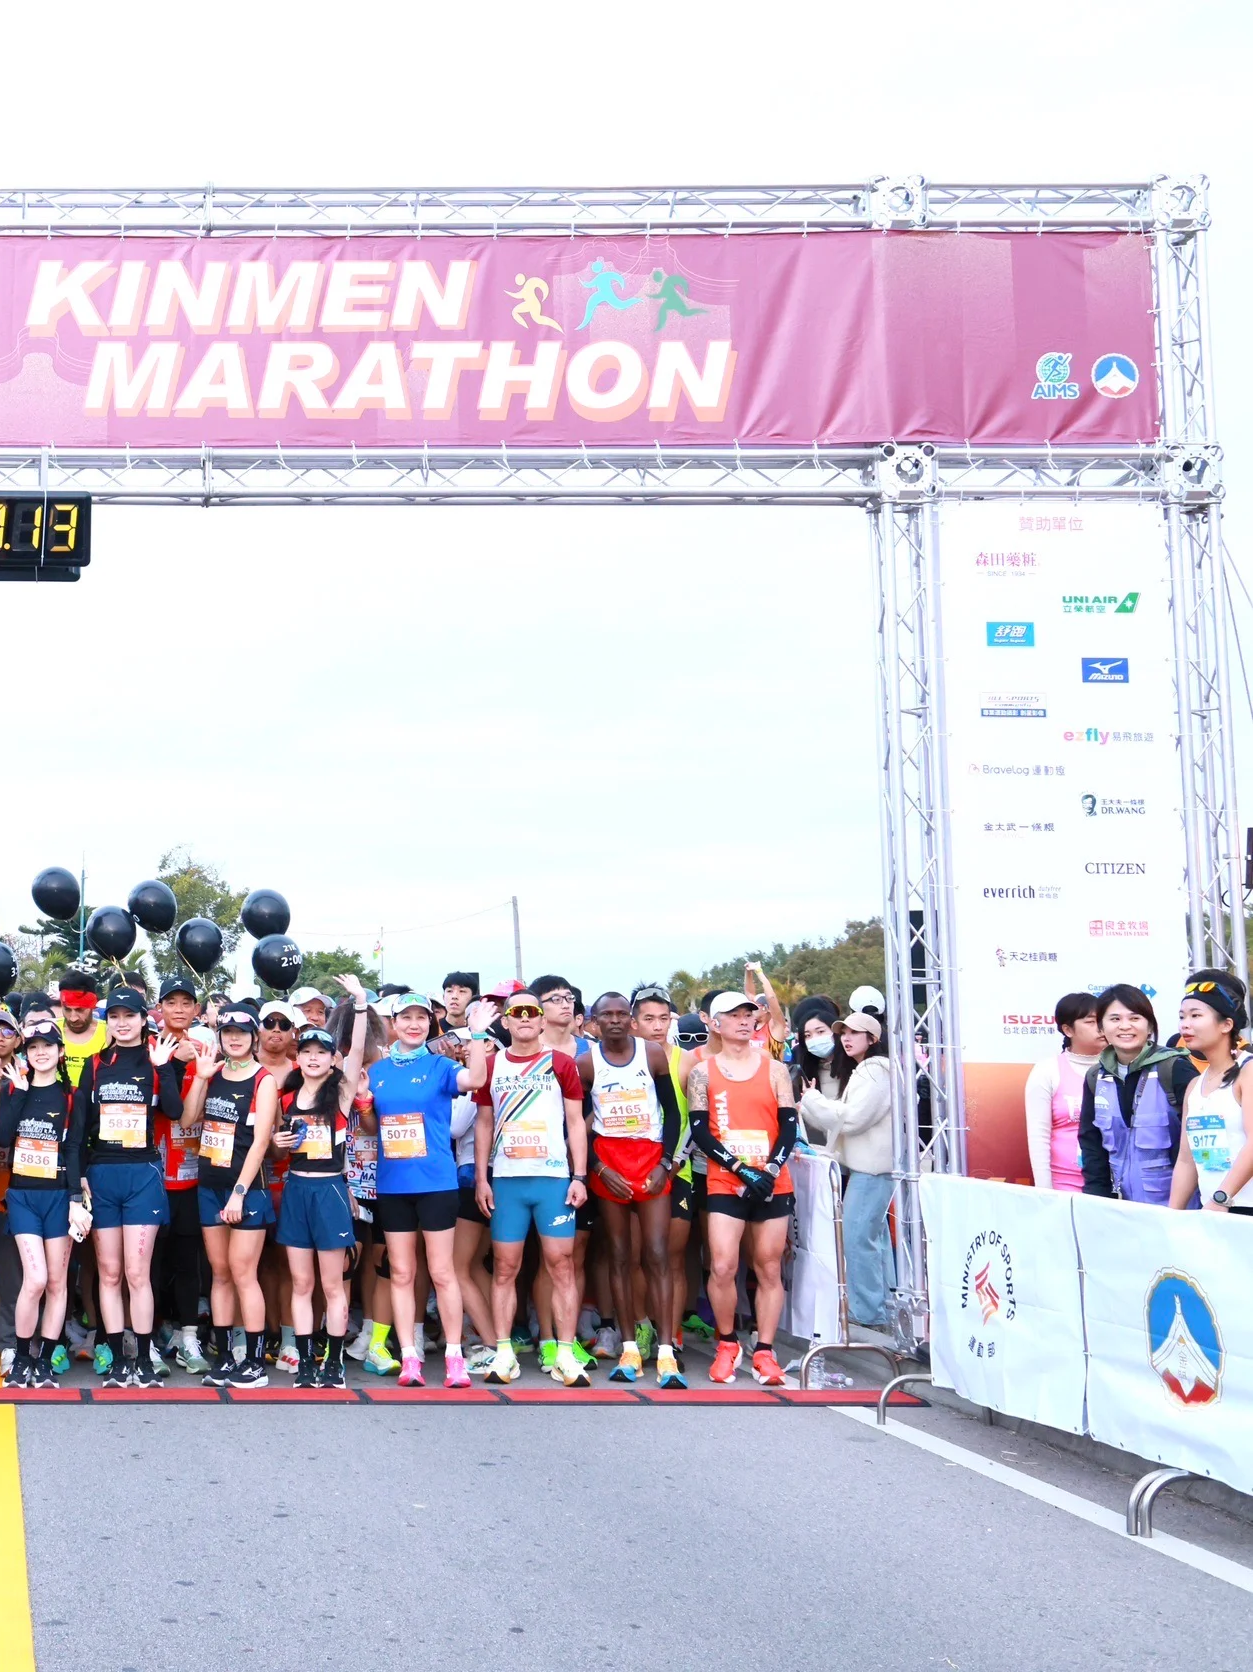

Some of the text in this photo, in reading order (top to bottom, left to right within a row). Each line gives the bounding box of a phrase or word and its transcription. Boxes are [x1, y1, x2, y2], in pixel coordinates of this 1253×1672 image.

[26, 260, 477, 335] KINMEN
[86, 340, 734, 421] MARATHON
[1032, 383, 1079, 399] AIMS
[1018, 516, 1084, 532] 贊助單位
[1062, 595, 1118, 604] UNI AIR
[1063, 728, 1110, 745] ezfly
[1084, 862, 1146, 875] CITIZEN
[983, 885, 1035, 899] everrich
[280, 955, 302, 968] 2:00
[1003, 1015, 1055, 1025] ISUZU
[610, 1104, 641, 1115] 4165
[109, 1119, 139, 1128] 5837
[388, 1129, 417, 1140] 5078
[510, 1135, 540, 1145] 3009
[1193, 1134, 1217, 1147] 9177
[205, 1136, 225, 1147] 5831
[730, 1145, 762, 1154] 3035
[20, 1153, 50, 1165] 5836
[961, 1230, 1017, 1322] MINISTRY OF SPORTS
